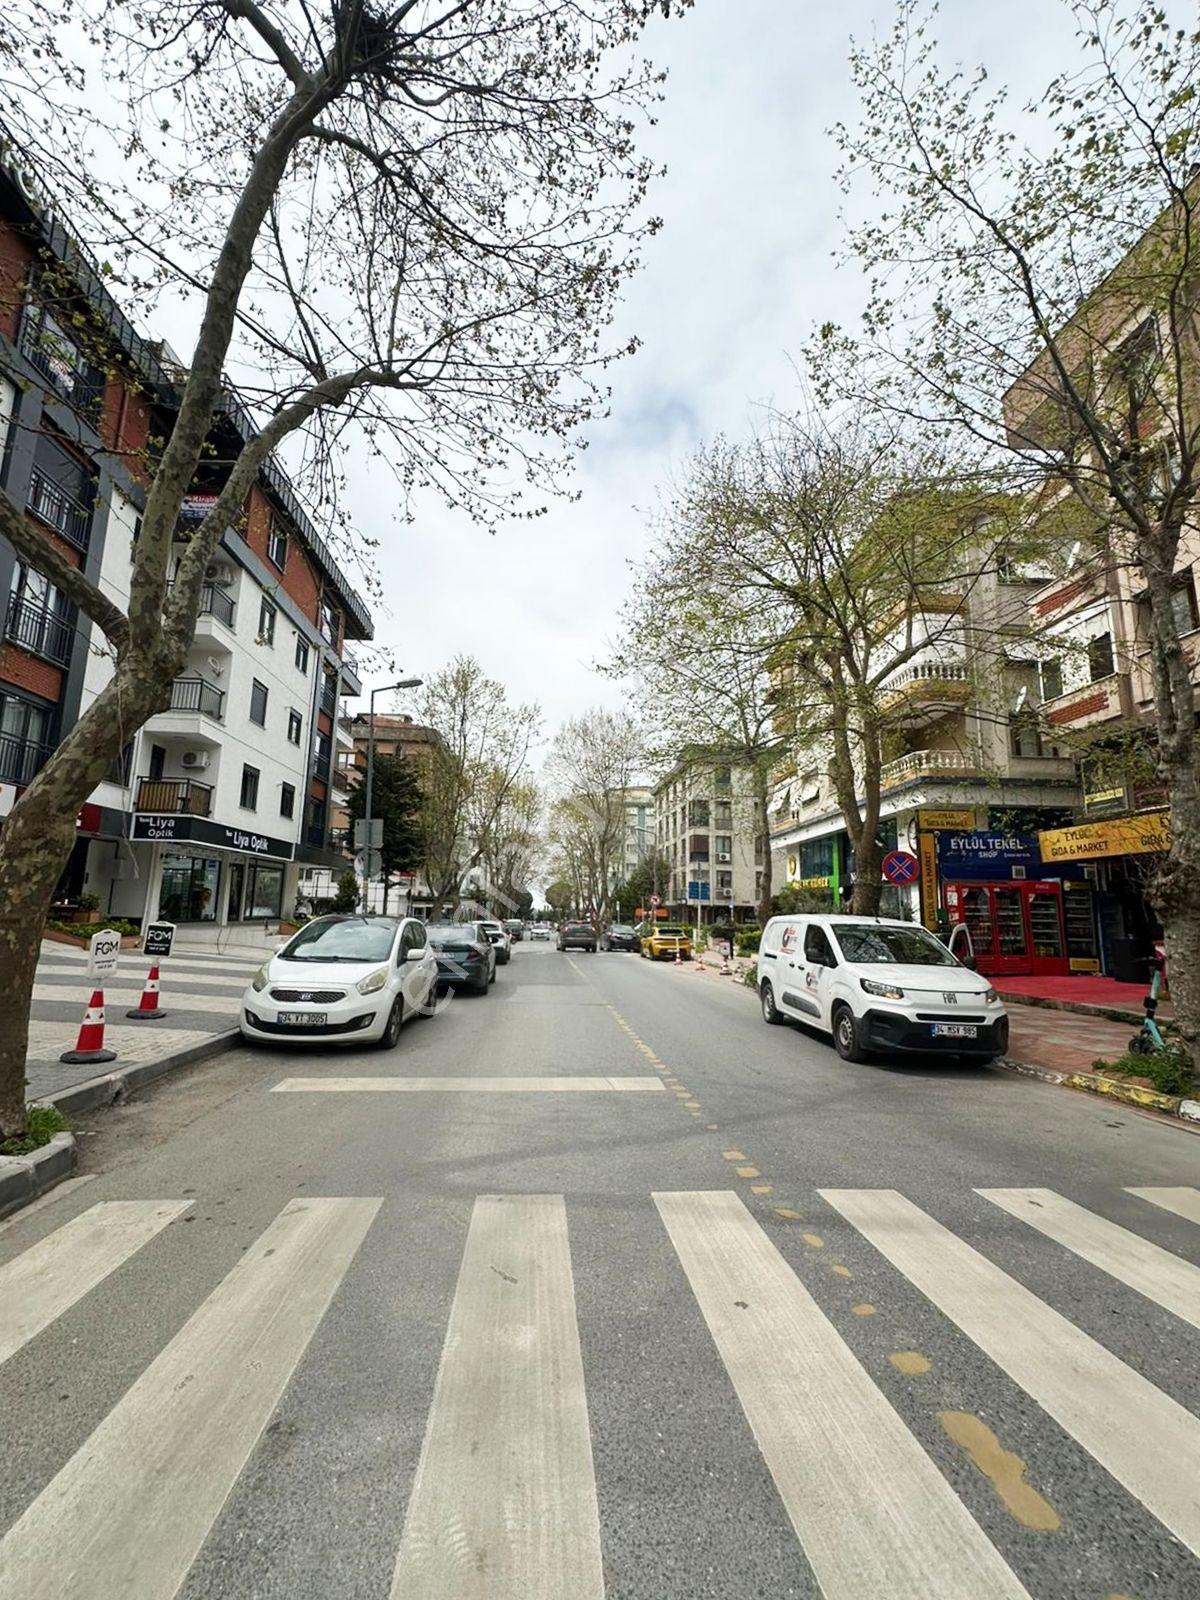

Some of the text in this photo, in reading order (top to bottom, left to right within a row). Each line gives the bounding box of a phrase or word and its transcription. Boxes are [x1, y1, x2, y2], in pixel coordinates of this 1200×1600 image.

[149, 817, 175, 830] Liya
[147, 829, 173, 839] Optik
[233, 831, 249, 848] Liya
[250, 835, 268, 851] Optik
[950, 836, 1023, 849] EYLÜL TEKEL
[1051, 841, 1108, 856] GIDA & MARKET
[95, 940, 119, 956] FGM
[282, 1013, 292, 1022] 34
[936, 1025, 944, 1034] 34
